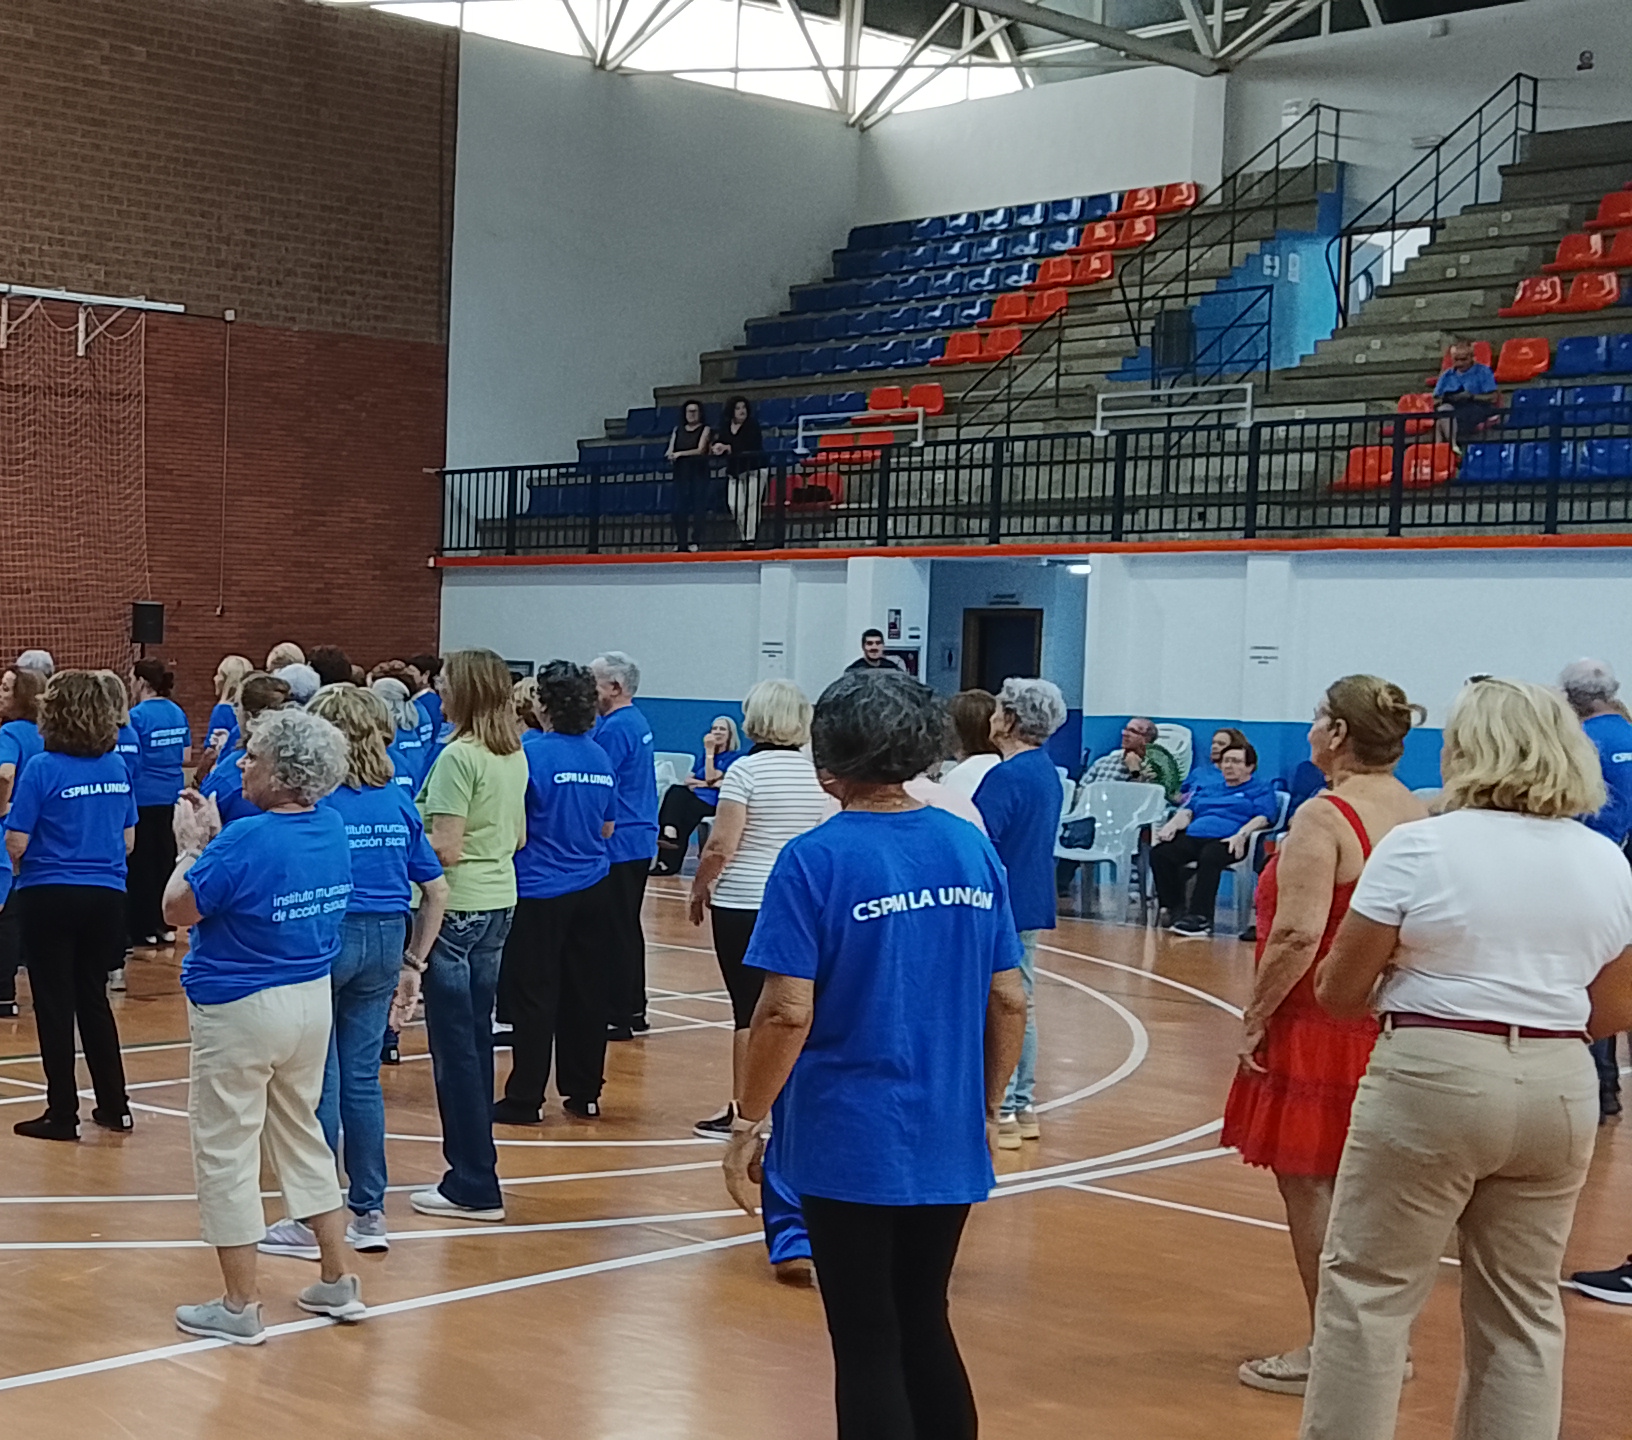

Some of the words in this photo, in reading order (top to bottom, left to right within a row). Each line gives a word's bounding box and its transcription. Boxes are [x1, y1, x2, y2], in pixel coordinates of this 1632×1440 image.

[90, 783, 103, 795] LA
[344, 823, 372, 836] tituto
[273, 889, 315, 907] instituto
[852, 893, 908, 922] CSPM
[908, 889, 936, 910] LA
[272, 908, 287, 923] de
[288, 902, 321, 920] acción
